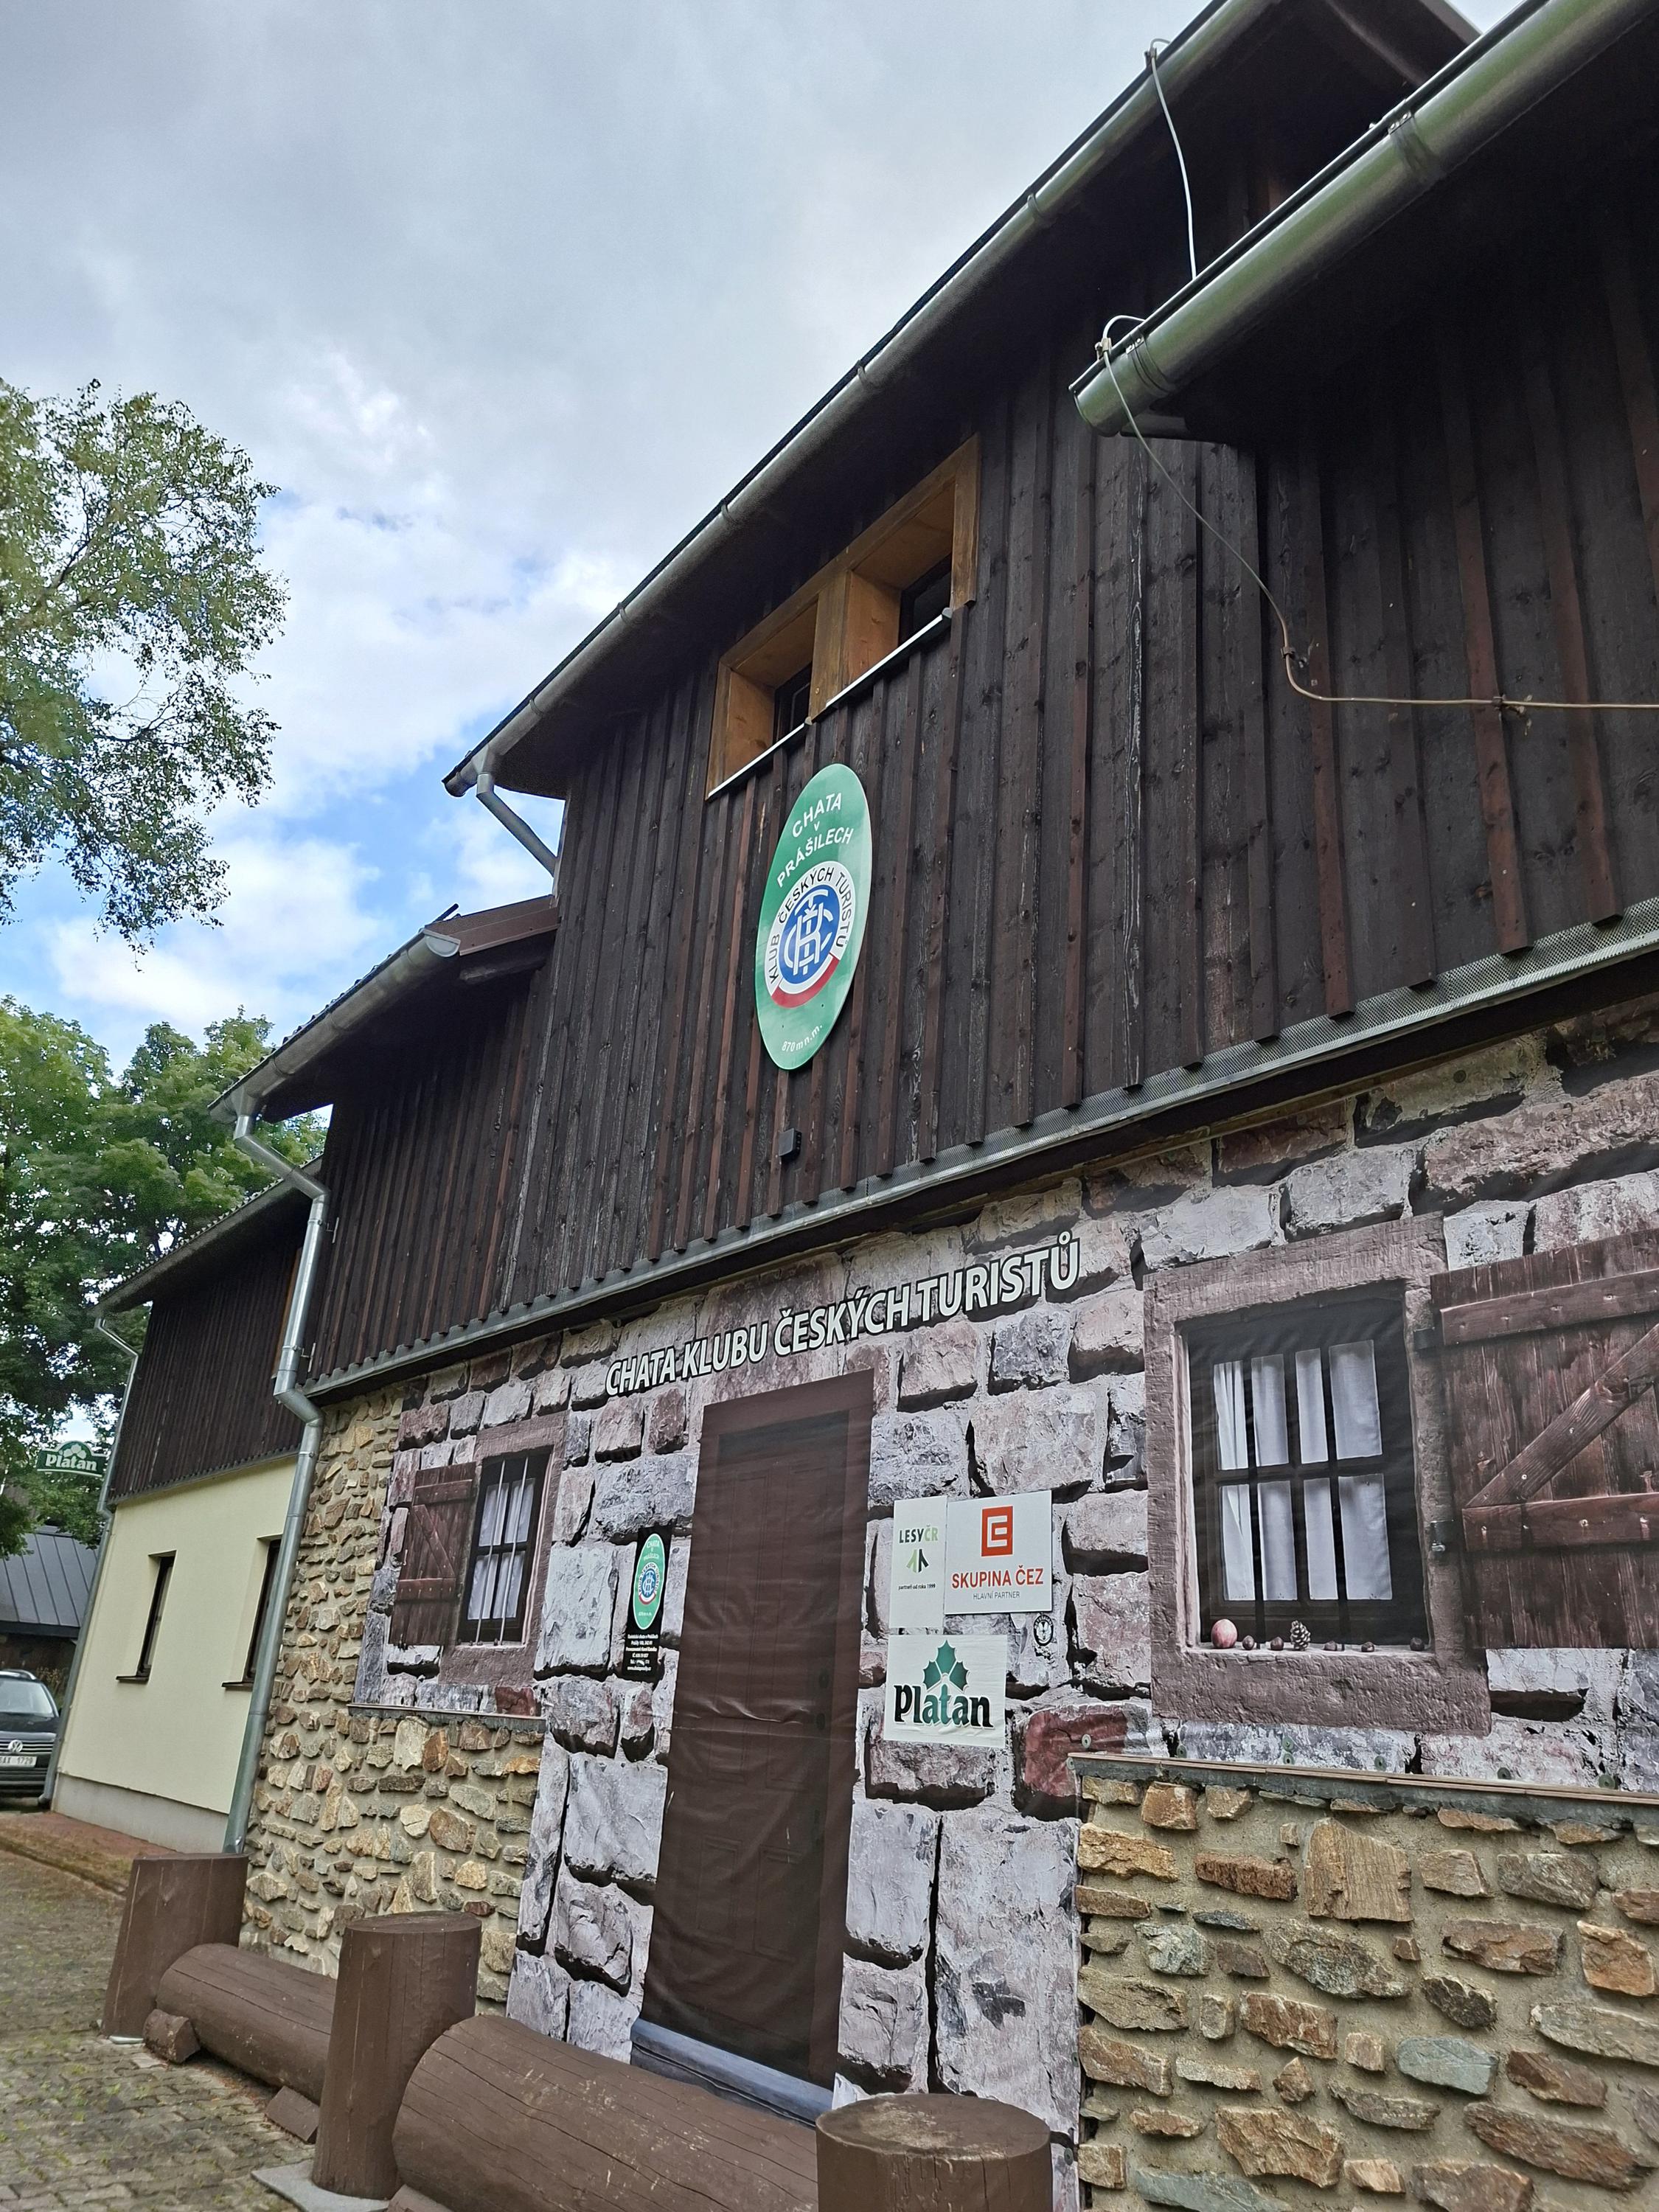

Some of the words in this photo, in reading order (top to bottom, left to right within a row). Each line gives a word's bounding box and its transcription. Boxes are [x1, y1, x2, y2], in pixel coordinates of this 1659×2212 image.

[793, 793, 842, 838] CHATA
[776, 827, 855, 888] PRÁŠILECH
[769, 933, 780, 984] KLUB
[777, 866, 835, 923] ČESKÝCH
[835, 872, 852, 948] TURISTŮ
[605, 1347, 676, 1396] CHATA
[681, 1323, 768, 1379] KLUBU
[773, 1285, 911, 1357] ČESKÝCH
[917, 1230, 1080, 1322] TURISTŮ
[45, 1453, 97, 1471] Platan
[952, 1570, 1012, 1589] SKUPINA
[1015, 1565, 1044, 1585] ČEZ
[973, 1590, 993, 1600] HLAVNÍ
[994, 1590, 1020, 1599] PARTNER
[893, 1683, 994, 1728] Platan
